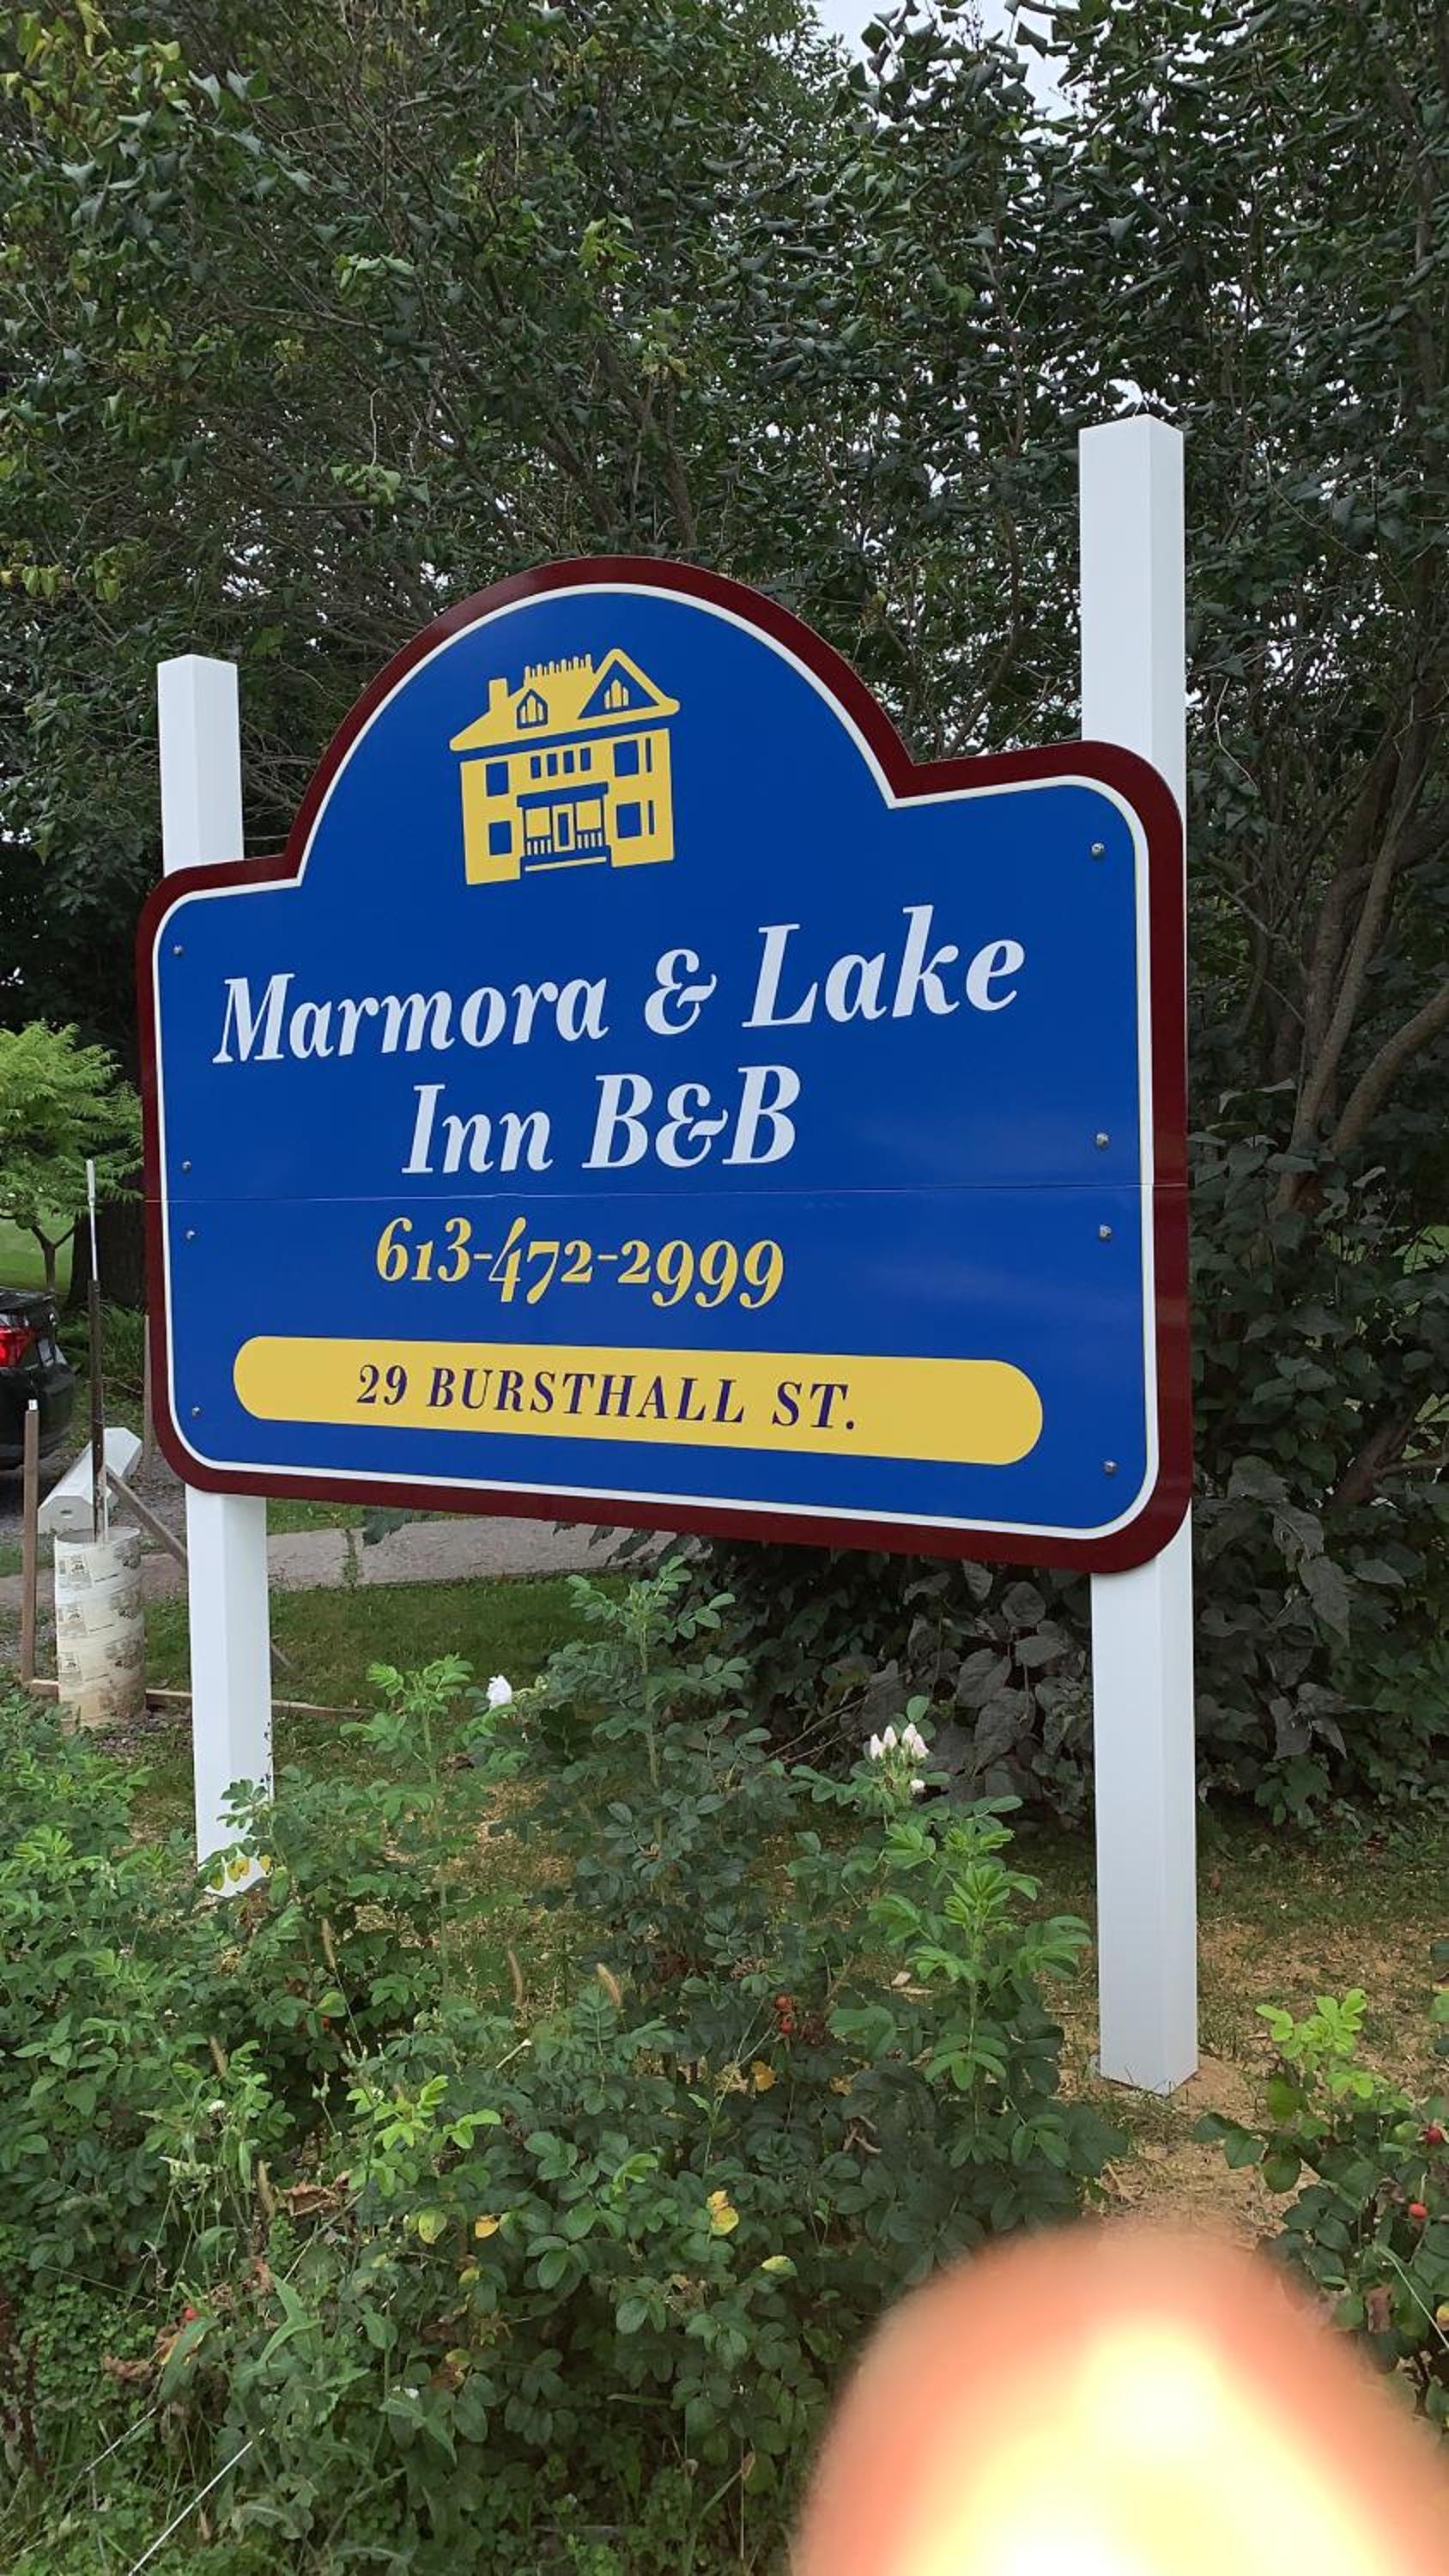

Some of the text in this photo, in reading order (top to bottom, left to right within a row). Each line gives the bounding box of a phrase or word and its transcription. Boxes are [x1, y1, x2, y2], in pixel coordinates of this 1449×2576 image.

[212, 905, 1025, 1065] Marmora & Lake
[401, 1065, 801, 1174] Inn B&B
[376, 1217, 784, 1309] 613-472-2999
[356, 1364, 855, 1431] 29 BURSTHALL ST.
